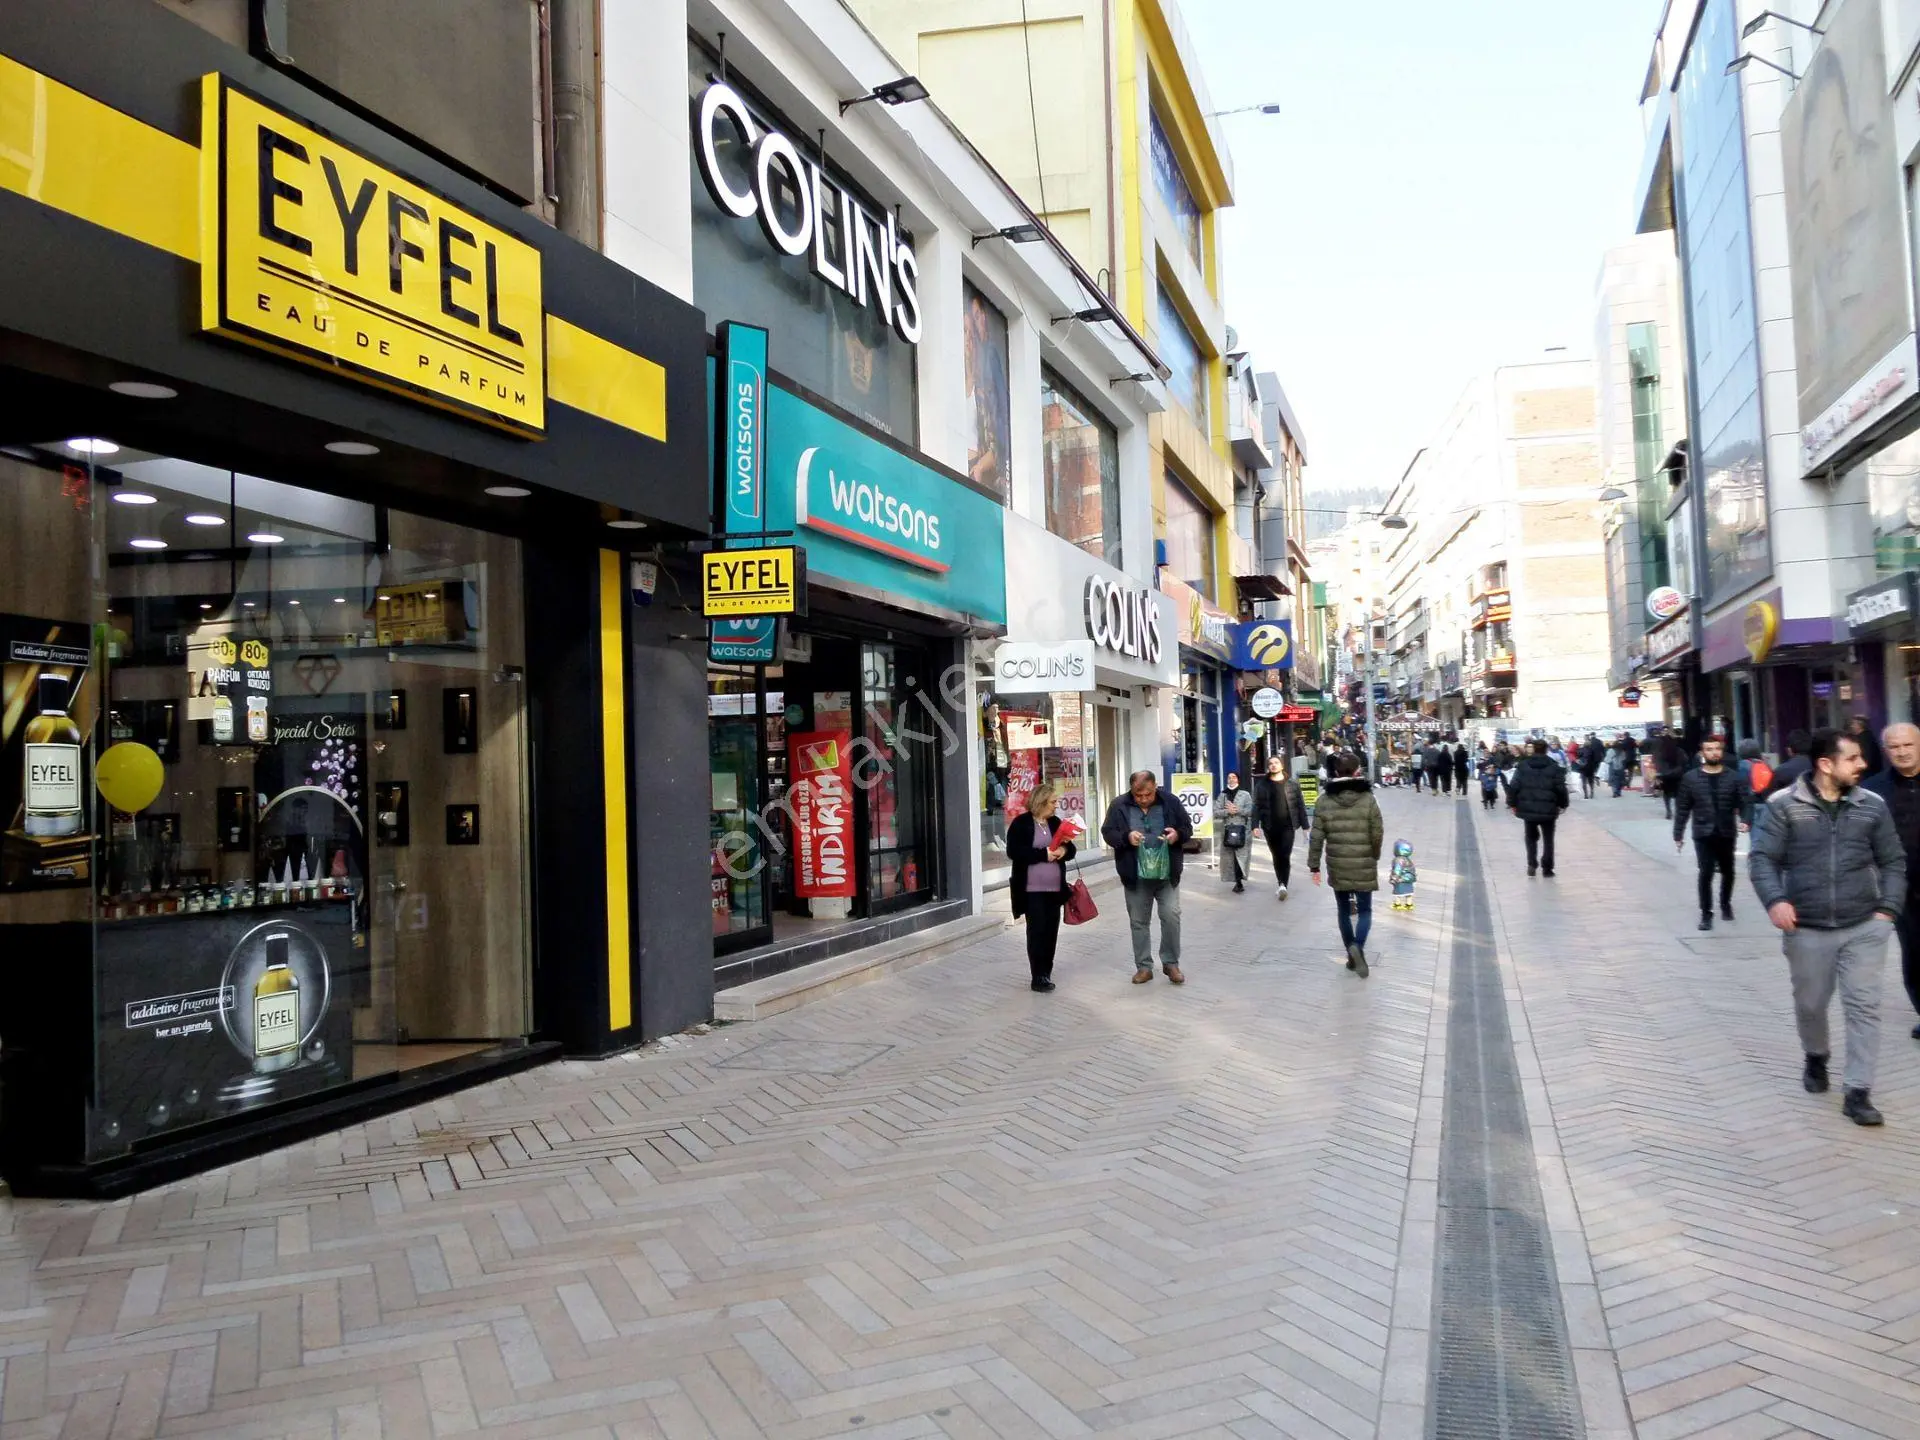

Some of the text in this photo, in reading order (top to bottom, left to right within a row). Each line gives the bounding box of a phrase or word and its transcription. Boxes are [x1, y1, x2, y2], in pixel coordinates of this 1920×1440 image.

[697, 83, 921, 344] COLIN'S
[258, 124, 524, 347] EYFEL
[257, 292, 526, 406] EAU DE PARFUM
[737, 382, 753, 494] watsons
[828, 470, 941, 549] watsons
[707, 559, 789, 591] EYFEL
[1084, 574, 1162, 665] COLIN'S
[712, 646, 772, 658] watsons
[1000, 652, 1084, 679] COLIN'S
[314, 715, 357, 740] Series
[31, 765, 75, 782] EYFEL
[800, 805, 811, 833] CLUB
[802, 834, 814, 886] WATSONS
[132, 1001, 179, 1020] addictive
[260, 1009, 293, 1028] EYFEL
[156, 1028, 169, 1038] her
